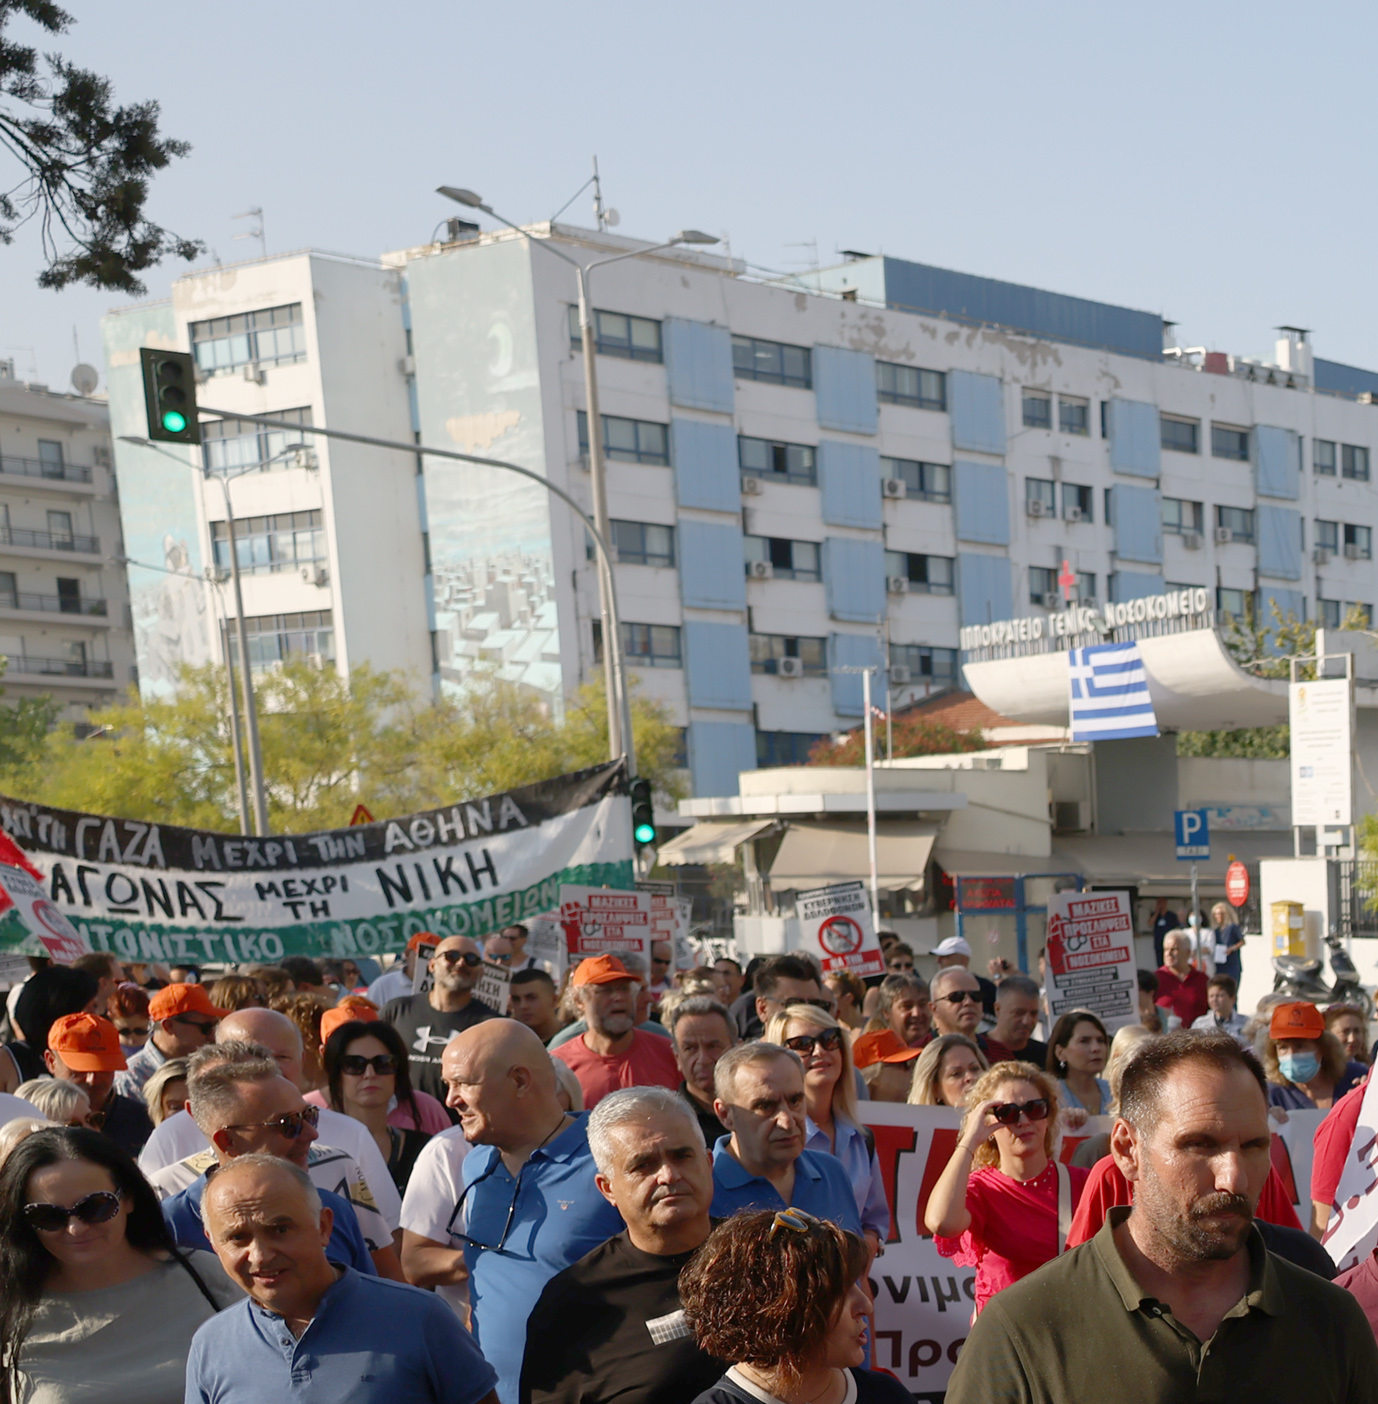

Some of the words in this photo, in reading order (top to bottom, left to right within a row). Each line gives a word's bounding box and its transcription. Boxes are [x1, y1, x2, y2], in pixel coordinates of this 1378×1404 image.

[1104, 587, 1208, 629] ΝΟΣΟΚΟΜΕΙΟ
[75, 818, 166, 868] ΓΑΖΑ
[192, 834, 298, 869] ΜΕΧΡΙ
[309, 832, 366, 862] ΤΗΝ
[384, 796, 528, 852] ΑΘΗΝΑ
[1182, 812, 1202, 844] P
[255, 874, 349, 901] ΜΕΧΡΙ
[375, 848, 499, 908] ΝΙΚΗ
[282, 900, 331, 920] ΤΗ
[1071, 899, 1118, 916] ΜΑΖΙΚΕΣ
[1063, 917, 1129, 937] ΠΡΟΣΛΗΨΕΙΣ
